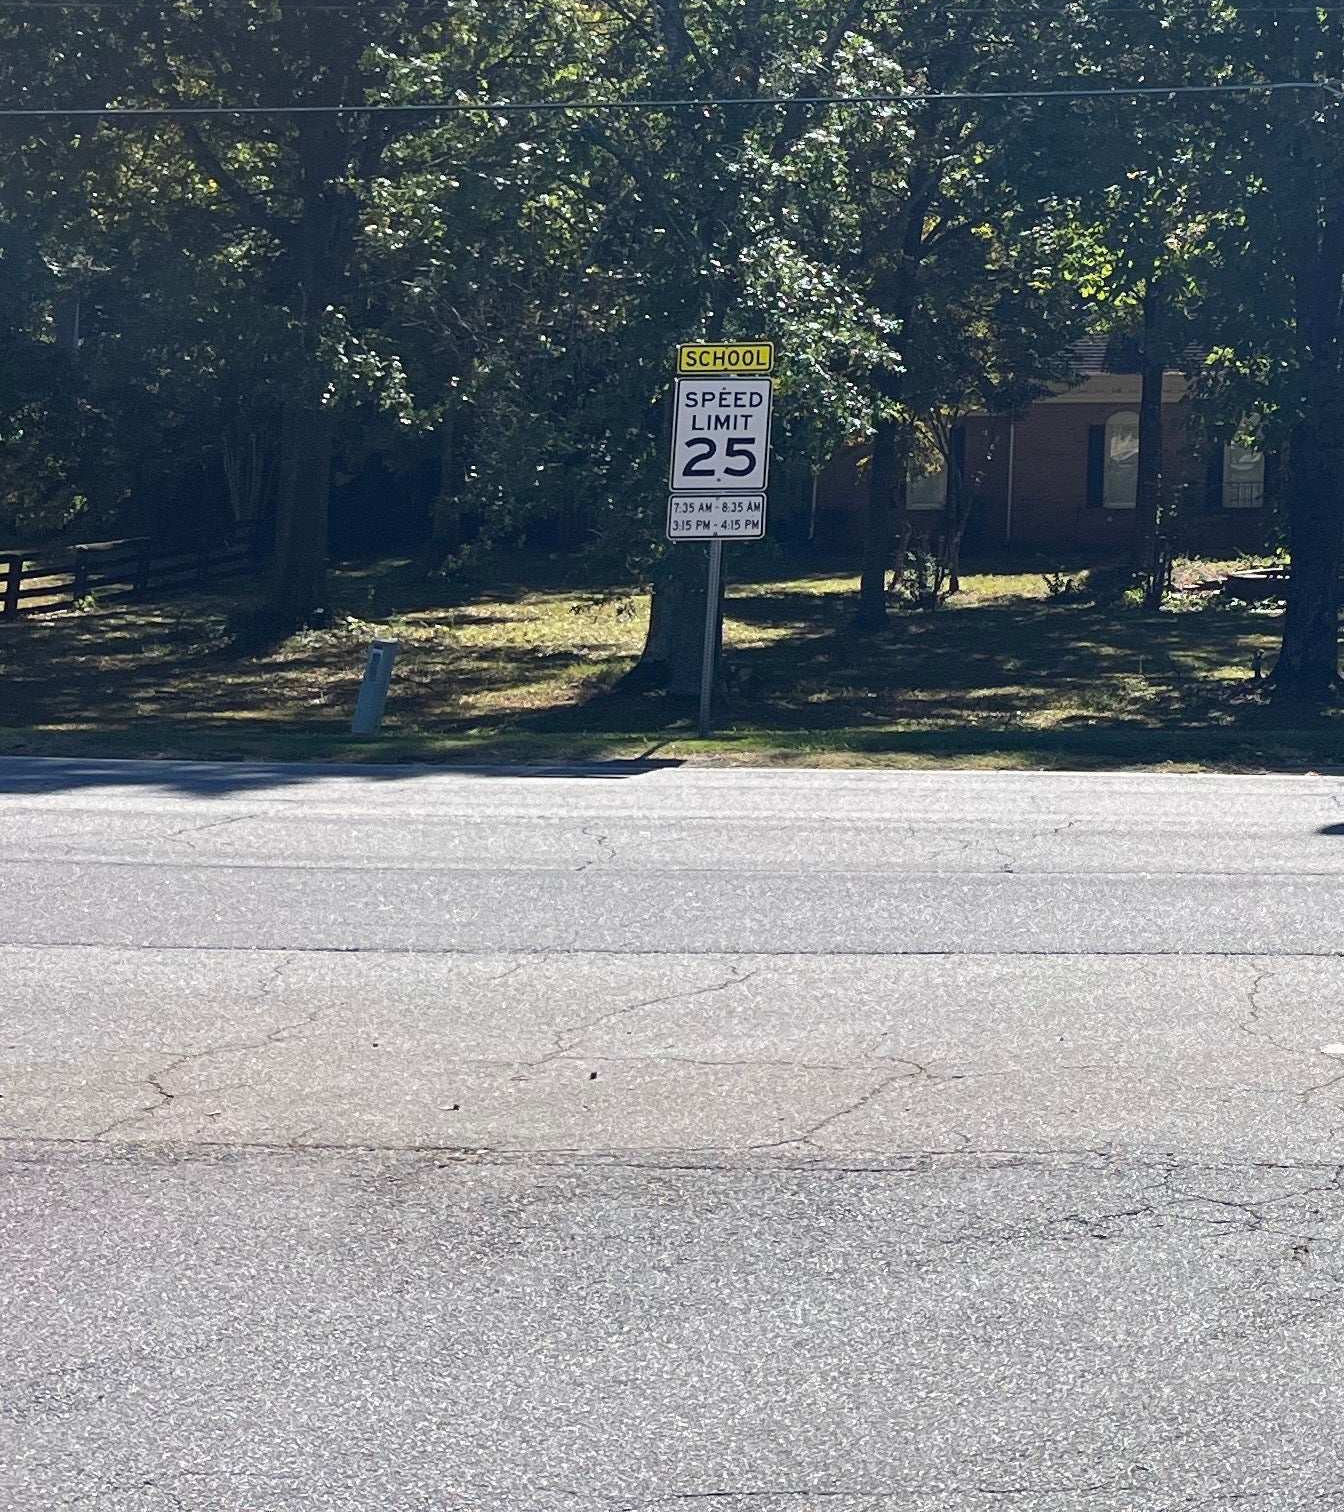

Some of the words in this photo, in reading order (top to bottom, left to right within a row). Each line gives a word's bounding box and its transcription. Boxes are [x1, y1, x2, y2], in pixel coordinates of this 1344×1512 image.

[685, 349, 767, 367] SCHOOL
[685, 391, 763, 408] SPEED
[691, 414, 753, 431] LIMIT
[682, 437, 757, 477] 25
[698, 502, 712, 513] AM
[721, 502, 743, 513] 8:35
[746, 501, 761, 512] AM
[672, 520, 692, 531] 3:15
[696, 520, 711, 530] PM
[720, 520, 741, 530] 4:15
[744, 520, 760, 530] PM
